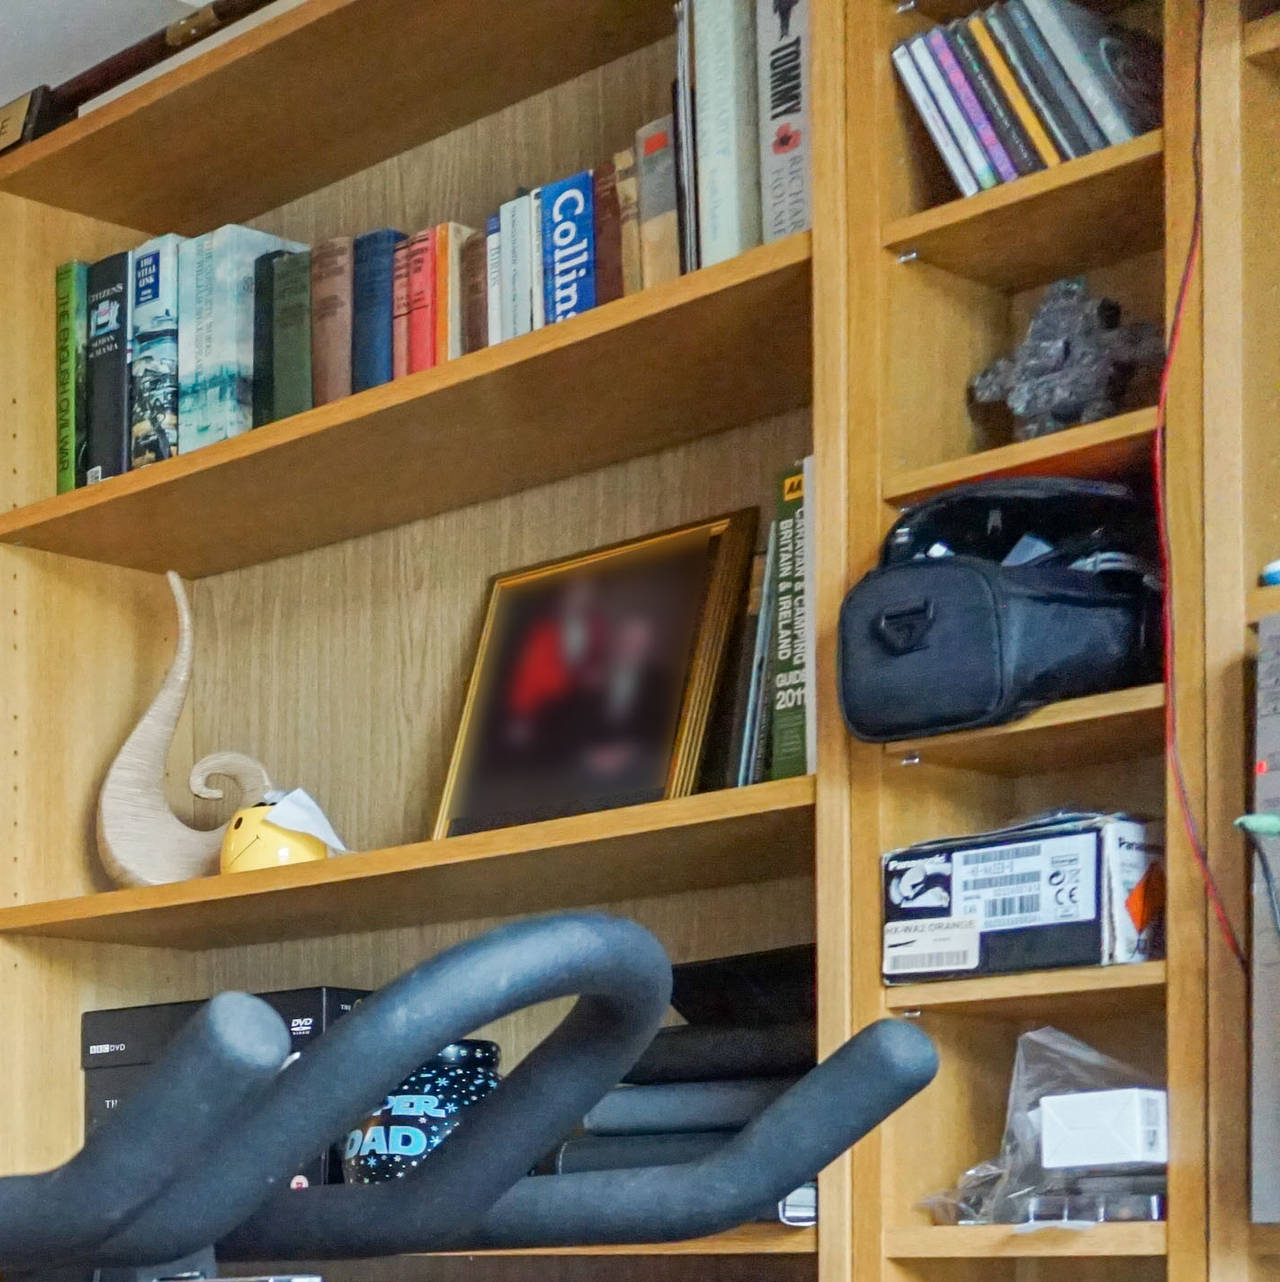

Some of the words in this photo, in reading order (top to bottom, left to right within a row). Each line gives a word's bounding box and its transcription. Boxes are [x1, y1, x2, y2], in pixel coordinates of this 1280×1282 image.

[769, 36, 802, 121] TOMMY
[771, 168, 786, 236] HOLME
[789, 154, 805, 233] RICHAR
[58, 294, 70, 323] THE
[58, 327, 70, 394] ENGLISH
[58, 397, 70, 433] CIVIL
[58, 434, 70, 472] WAR
[778, 518, 793, 579] BRITAIN
[778, 582, 792, 593] &
[777, 594, 793, 661] IRELAND
[888, 853, 947, 871] Panasonic
[928, 920, 977, 932] ORANGE
[291, 1018, 313, 1027] DVD
[109, 1043, 126, 1053] DVD
[105, 1099, 118, 1109] TH
[372, 1094, 446, 1118] PER
[344, 1125, 428, 1160] DAD
